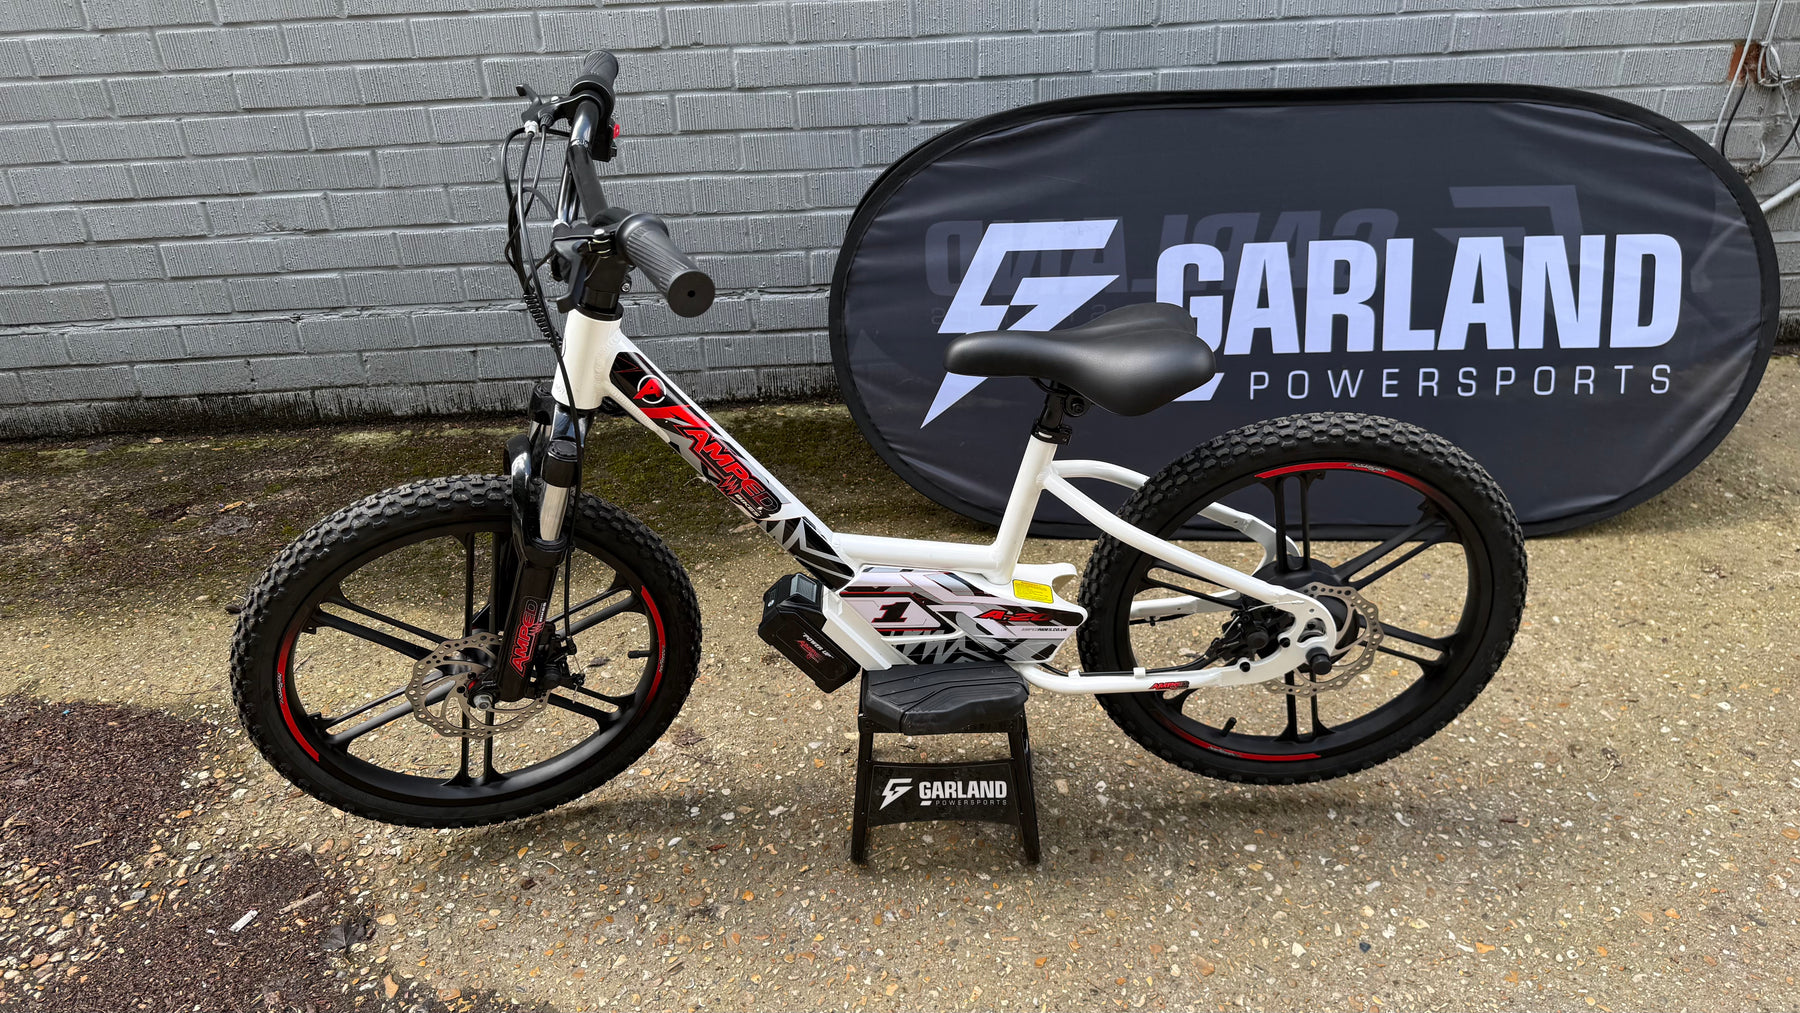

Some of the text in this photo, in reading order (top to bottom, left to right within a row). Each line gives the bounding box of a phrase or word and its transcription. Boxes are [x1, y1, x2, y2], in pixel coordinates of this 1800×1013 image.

[1156, 233, 1682, 355] GARLAND
[1249, 364, 1672, 400] POWERSPORTS
[683, 429, 779, 512] AMPED
[512, 600, 538, 672] AMPED
[871, 601, 911, 623] 1
[918, 780, 1008, 799] GARLAND
